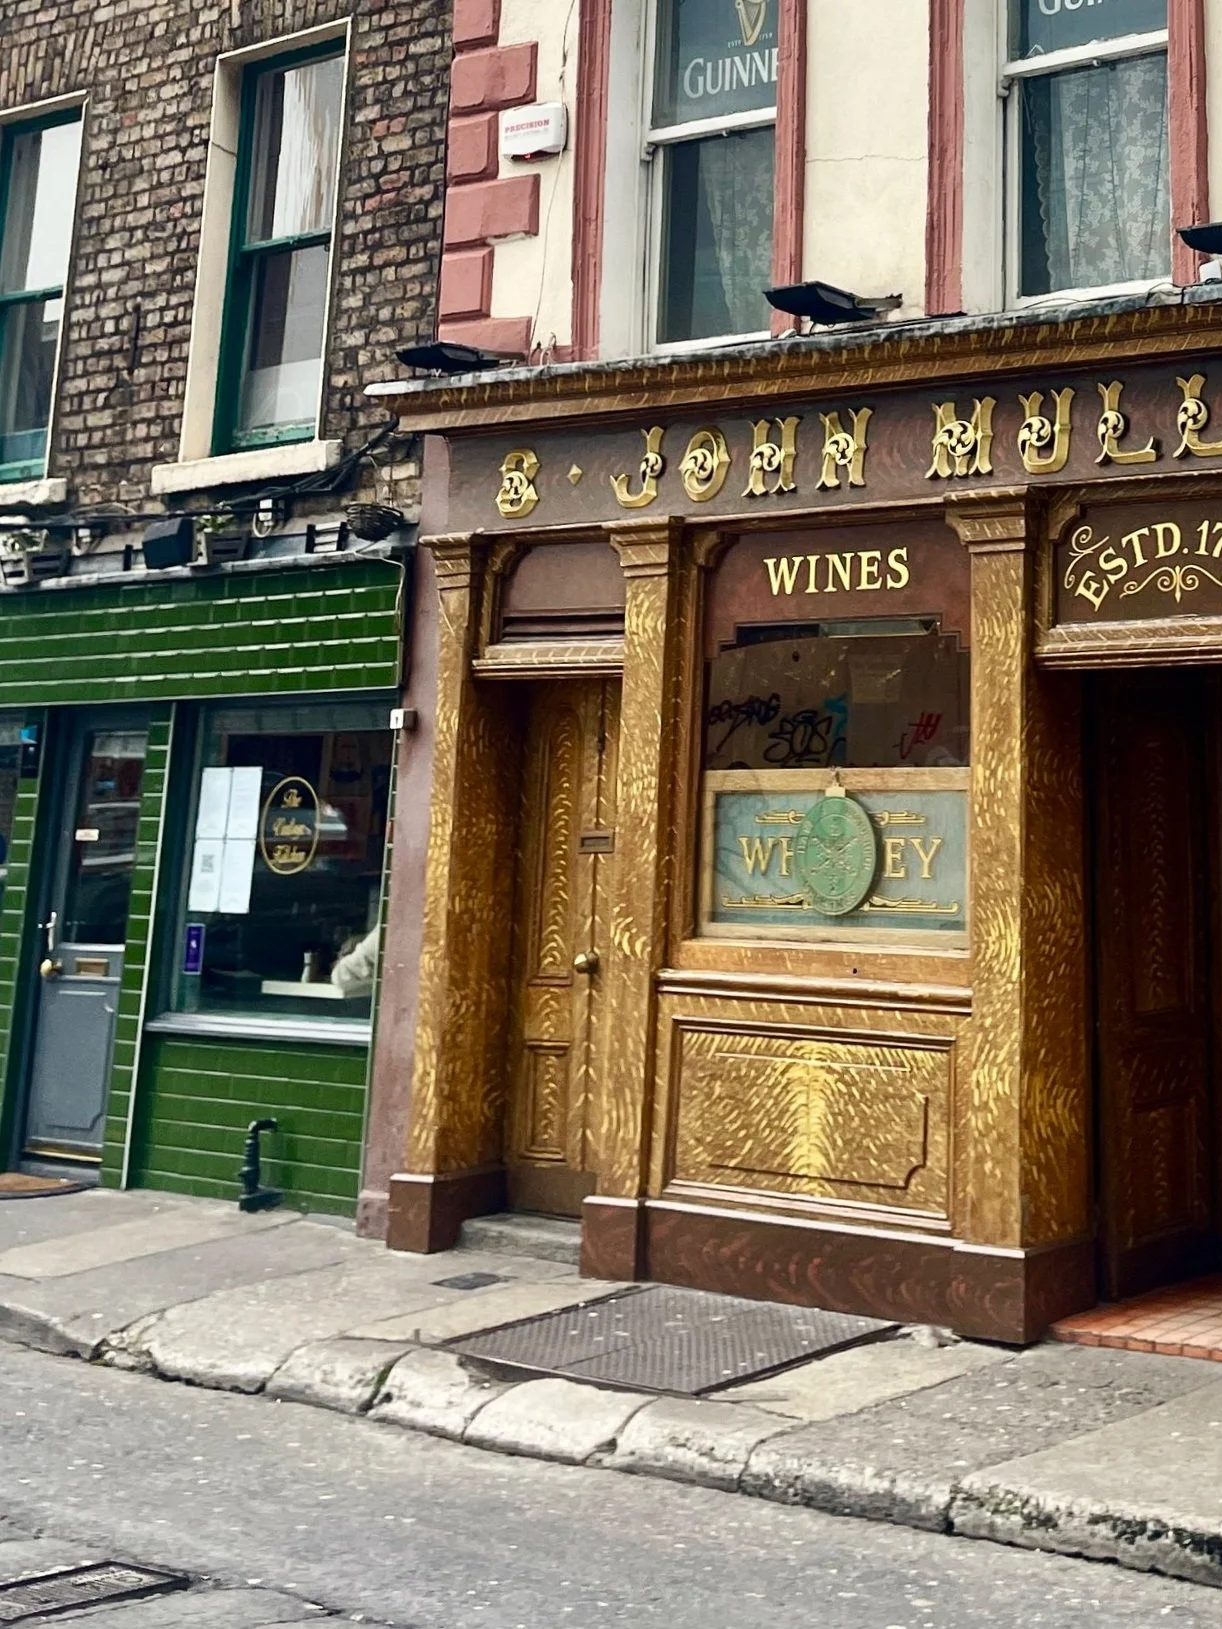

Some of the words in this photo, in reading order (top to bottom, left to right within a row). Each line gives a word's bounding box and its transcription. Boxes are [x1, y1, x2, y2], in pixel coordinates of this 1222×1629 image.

[504, 118, 551, 133] PRECISION
[609, 407, 873, 508] JOHN
[763, 547, 910, 596] WINES
[737, 835, 944, 880] WHEY
